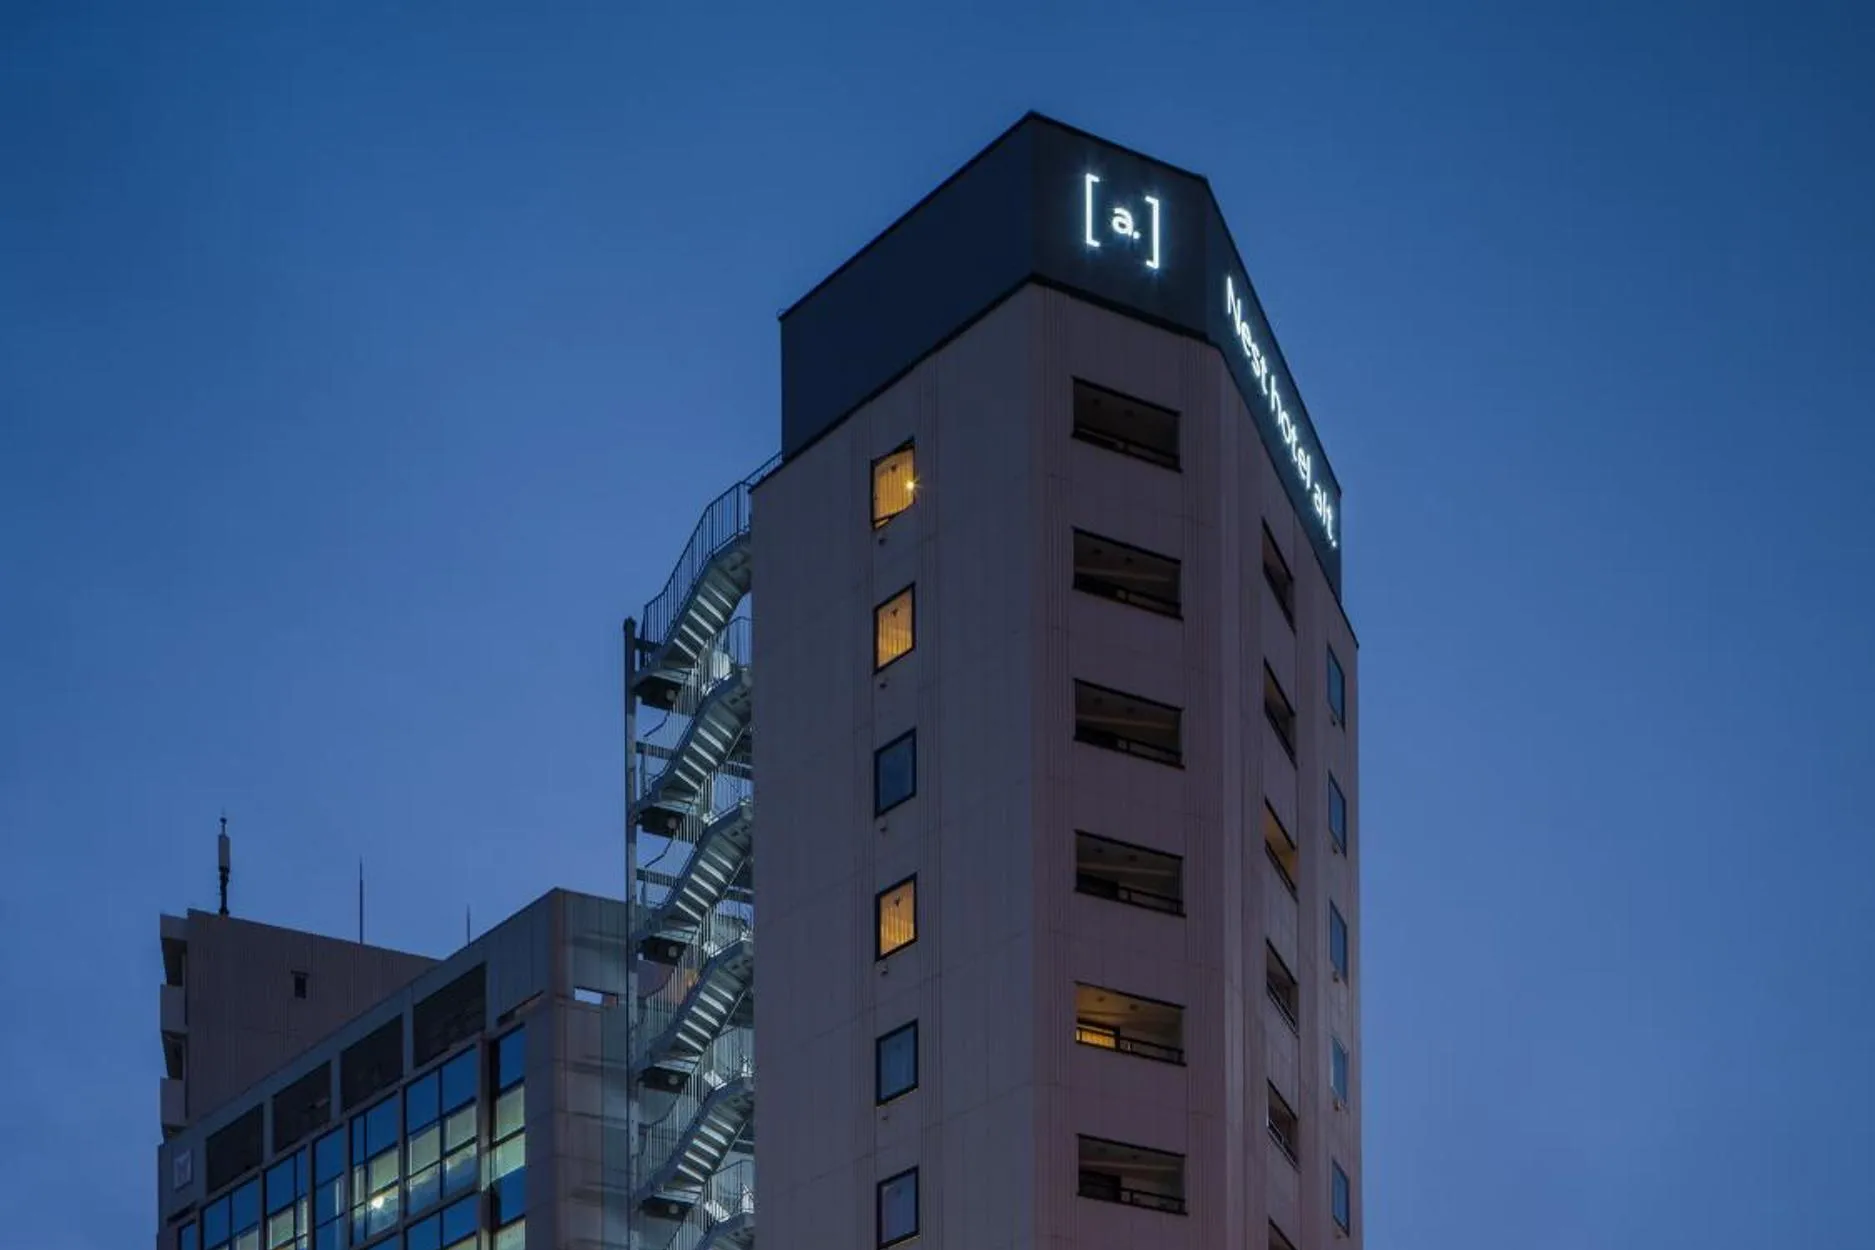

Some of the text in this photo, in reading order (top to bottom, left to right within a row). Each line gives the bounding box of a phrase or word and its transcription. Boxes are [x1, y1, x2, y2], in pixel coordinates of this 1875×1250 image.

[1226, 275, 1338, 548] Nest hotel alt.
